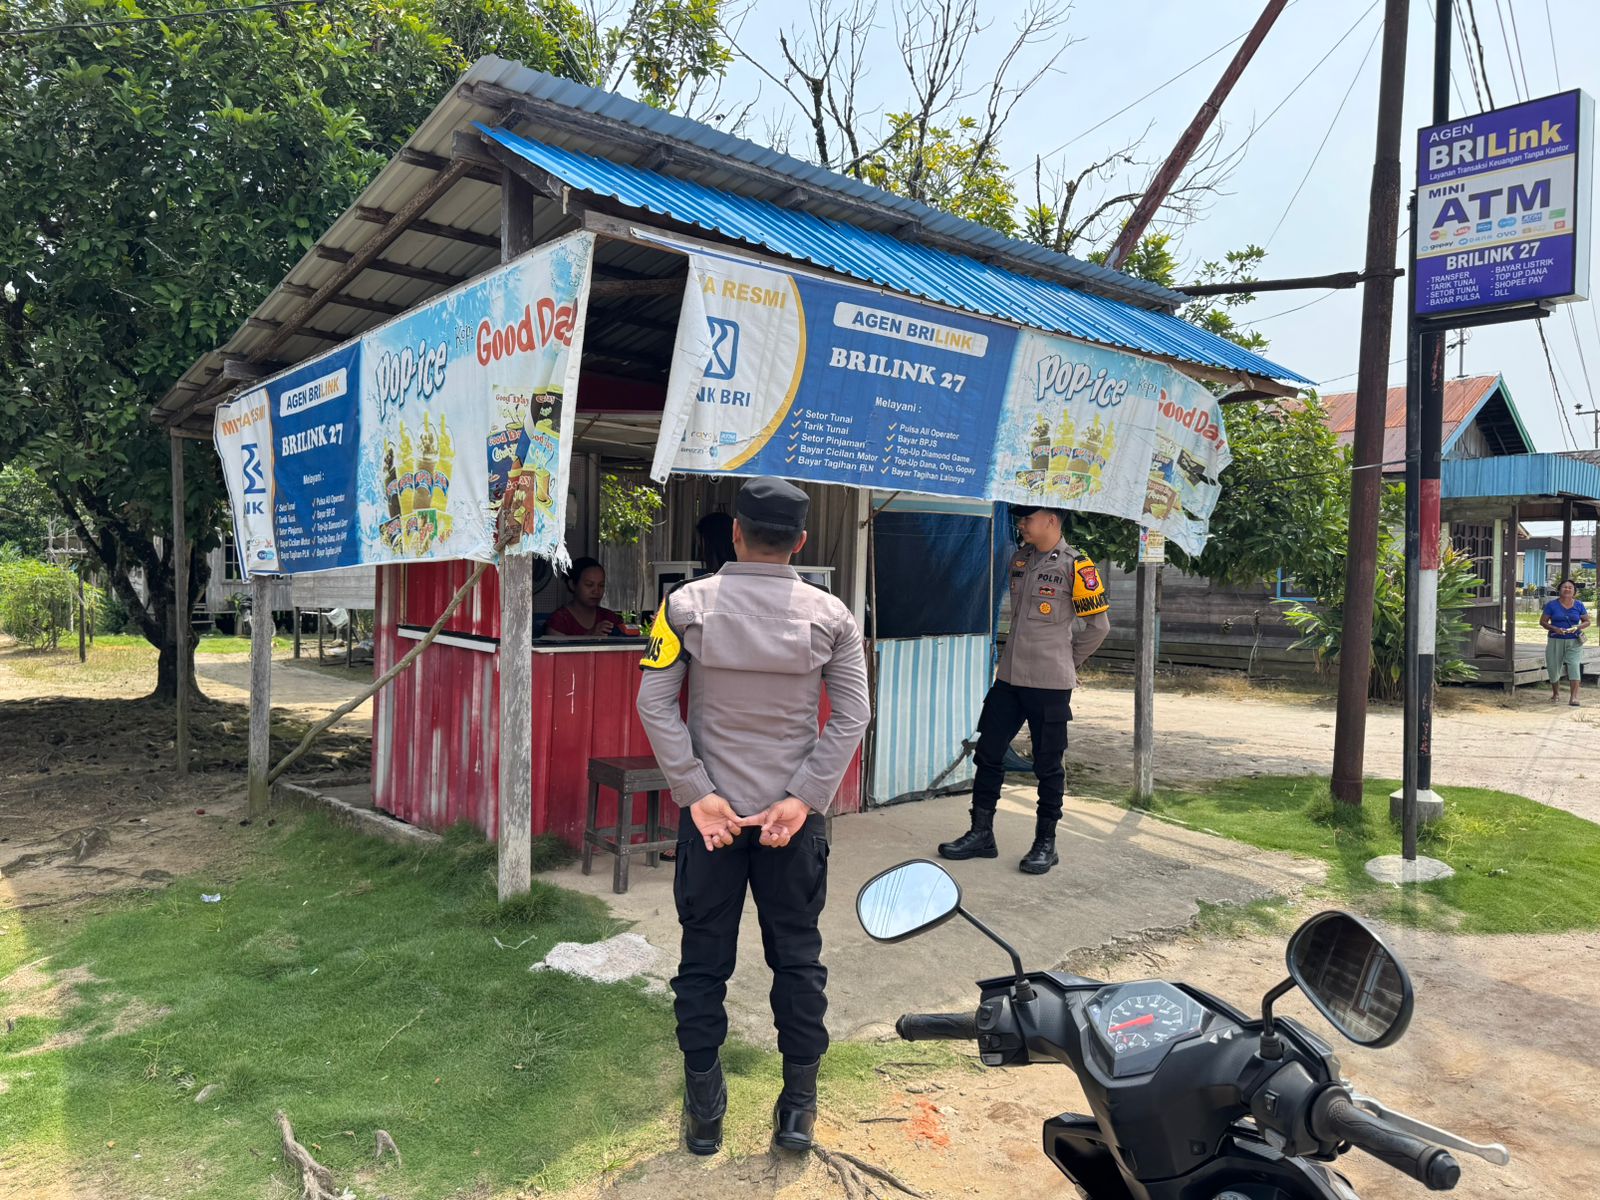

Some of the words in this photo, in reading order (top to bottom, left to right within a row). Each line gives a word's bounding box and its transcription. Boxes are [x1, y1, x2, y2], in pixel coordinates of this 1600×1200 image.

[1429, 123, 1473, 143] AGEN
[1429, 120, 1562, 171] BRILink
[1430, 170, 1456, 181] Layanan
[1458, 161, 1488, 174] Transaksi
[1489, 155, 1522, 168] Keuangan
[1524, 149, 1544, 160] Tanpa
[1545, 144, 1569, 155] Kantor
[1429, 183, 1465, 199] MINI
[1432, 178, 1551, 229] ATM
[1446, 246, 1514, 271] BRILINK
[1519, 241, 1540, 259] 27
[1495, 264, 1521, 274] BAYAR
[1523, 258, 1554, 269] LISTRIK
[1495, 273, 1511, 281] TOP
[1512, 271, 1524, 279] UP
[1525, 267, 1548, 277] DANA
[1431, 271, 1470, 283] TRANSFER
[1431, 281, 1451, 291] TARIK
[1454, 278, 1476, 287] TUNAI
[1495, 279, 1527, 289] SHOPEE
[1528, 276, 1544, 284] PAY
[722, 280, 787, 309] RESMI
[1430, 289, 1455, 298] SETOR
[1457, 285, 1479, 294] TUNAI
[1430, 296, 1454, 306] BAYAR
[1455, 293, 1481, 302] PULSA
[476, 304, 535, 366] Good
[852, 311, 902, 334] AGEN
[906, 323, 973, 350] BRILINK
[829, 347, 936, 385] BRILINK
[940, 371, 967, 393] 27
[287, 390, 307, 411] AGEN
[309, 376, 339, 402] BRILINK
[720, 389, 751, 407] BRI
[875, 396, 917, 413] Melayani
[805, 409, 828, 420] Setor
[830, 413, 853, 424] Tunai
[804, 421, 824, 431] Tarik
[826, 424, 849, 435] Tunai
[899, 423, 919, 433] Pulsa
[920, 427, 930, 435] All
[931, 429, 960, 441] Operator
[282, 424, 328, 457] BRILINK
[329, 423, 343, 446] 27
[801, 433, 824, 443] Setor
[826, 437, 865, 449] Pinjaman
[898, 434, 918, 446] Bayar
[919, 438, 937, 448] BPJS
[800, 444, 824, 456] Bayar
[826, 447, 854, 459] Cicilan
[857, 451, 878, 462] Motor
[896, 446, 920, 457] Top-Up
[921, 449, 951, 460] Diamond
[951, 454, 970, 463] Game
[798, 456, 822, 467] Bayar
[824, 459, 857, 470] Tagihan
[859, 464, 874, 472] PLN
[894, 457, 918, 468] Top-Up
[955, 465, 976, 476] Gopay
[891, 467, 912, 478] Bayar
[913, 470, 939, 480] Tagihan
[1038, 573, 1063, 585] POLRI
